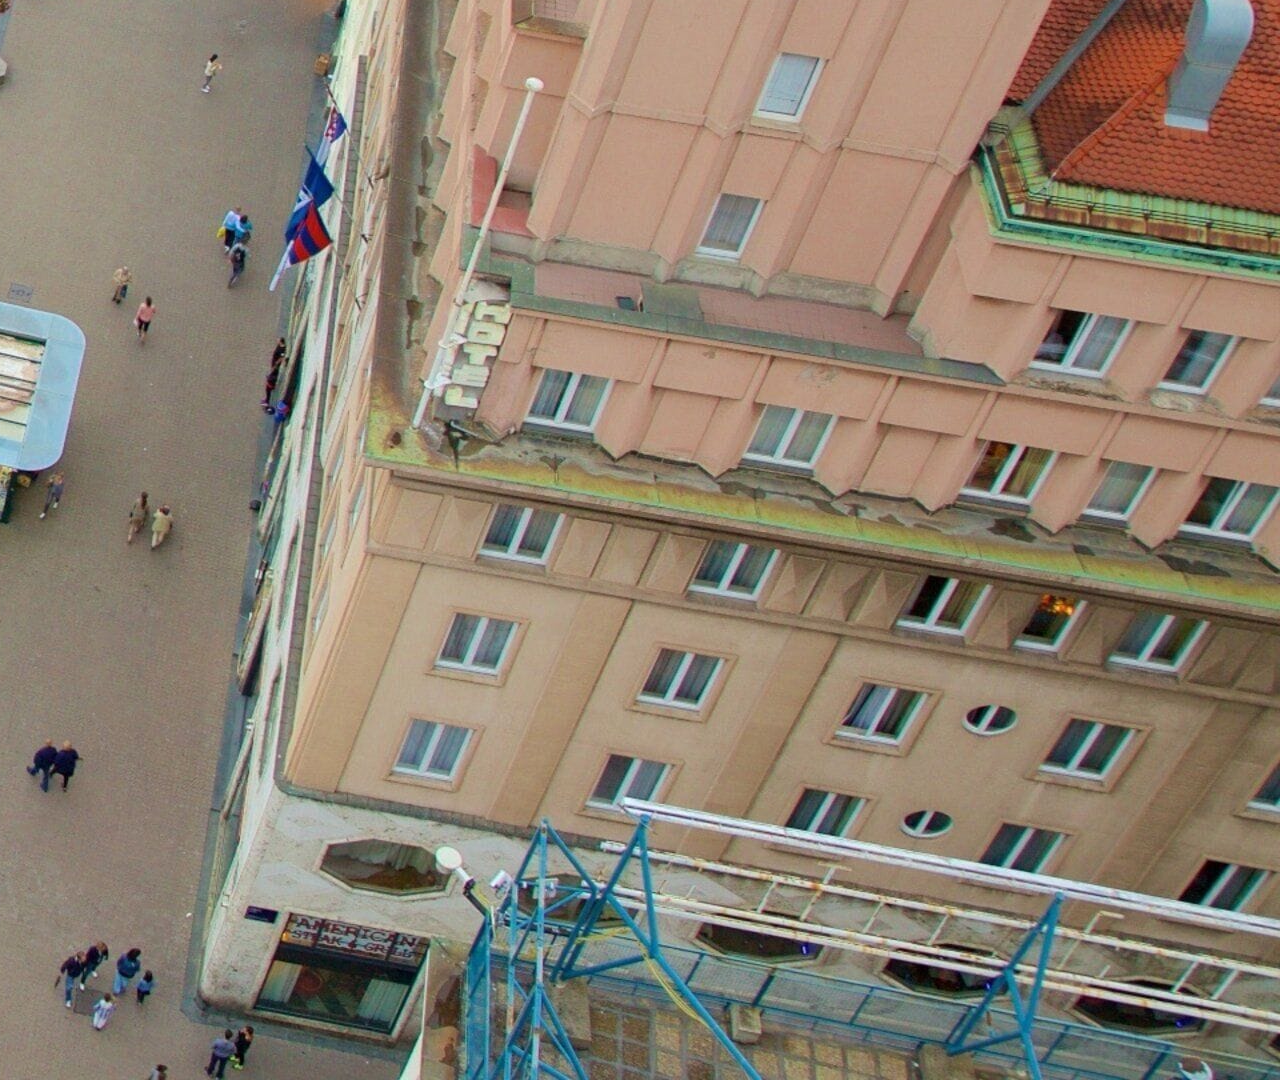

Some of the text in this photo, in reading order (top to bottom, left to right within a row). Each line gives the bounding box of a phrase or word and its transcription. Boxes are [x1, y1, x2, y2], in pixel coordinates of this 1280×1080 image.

[291, 929, 343, 949] STEAK
[364, 940, 416, 959] GRILL
[296, 917, 417, 948] AMERICAN
